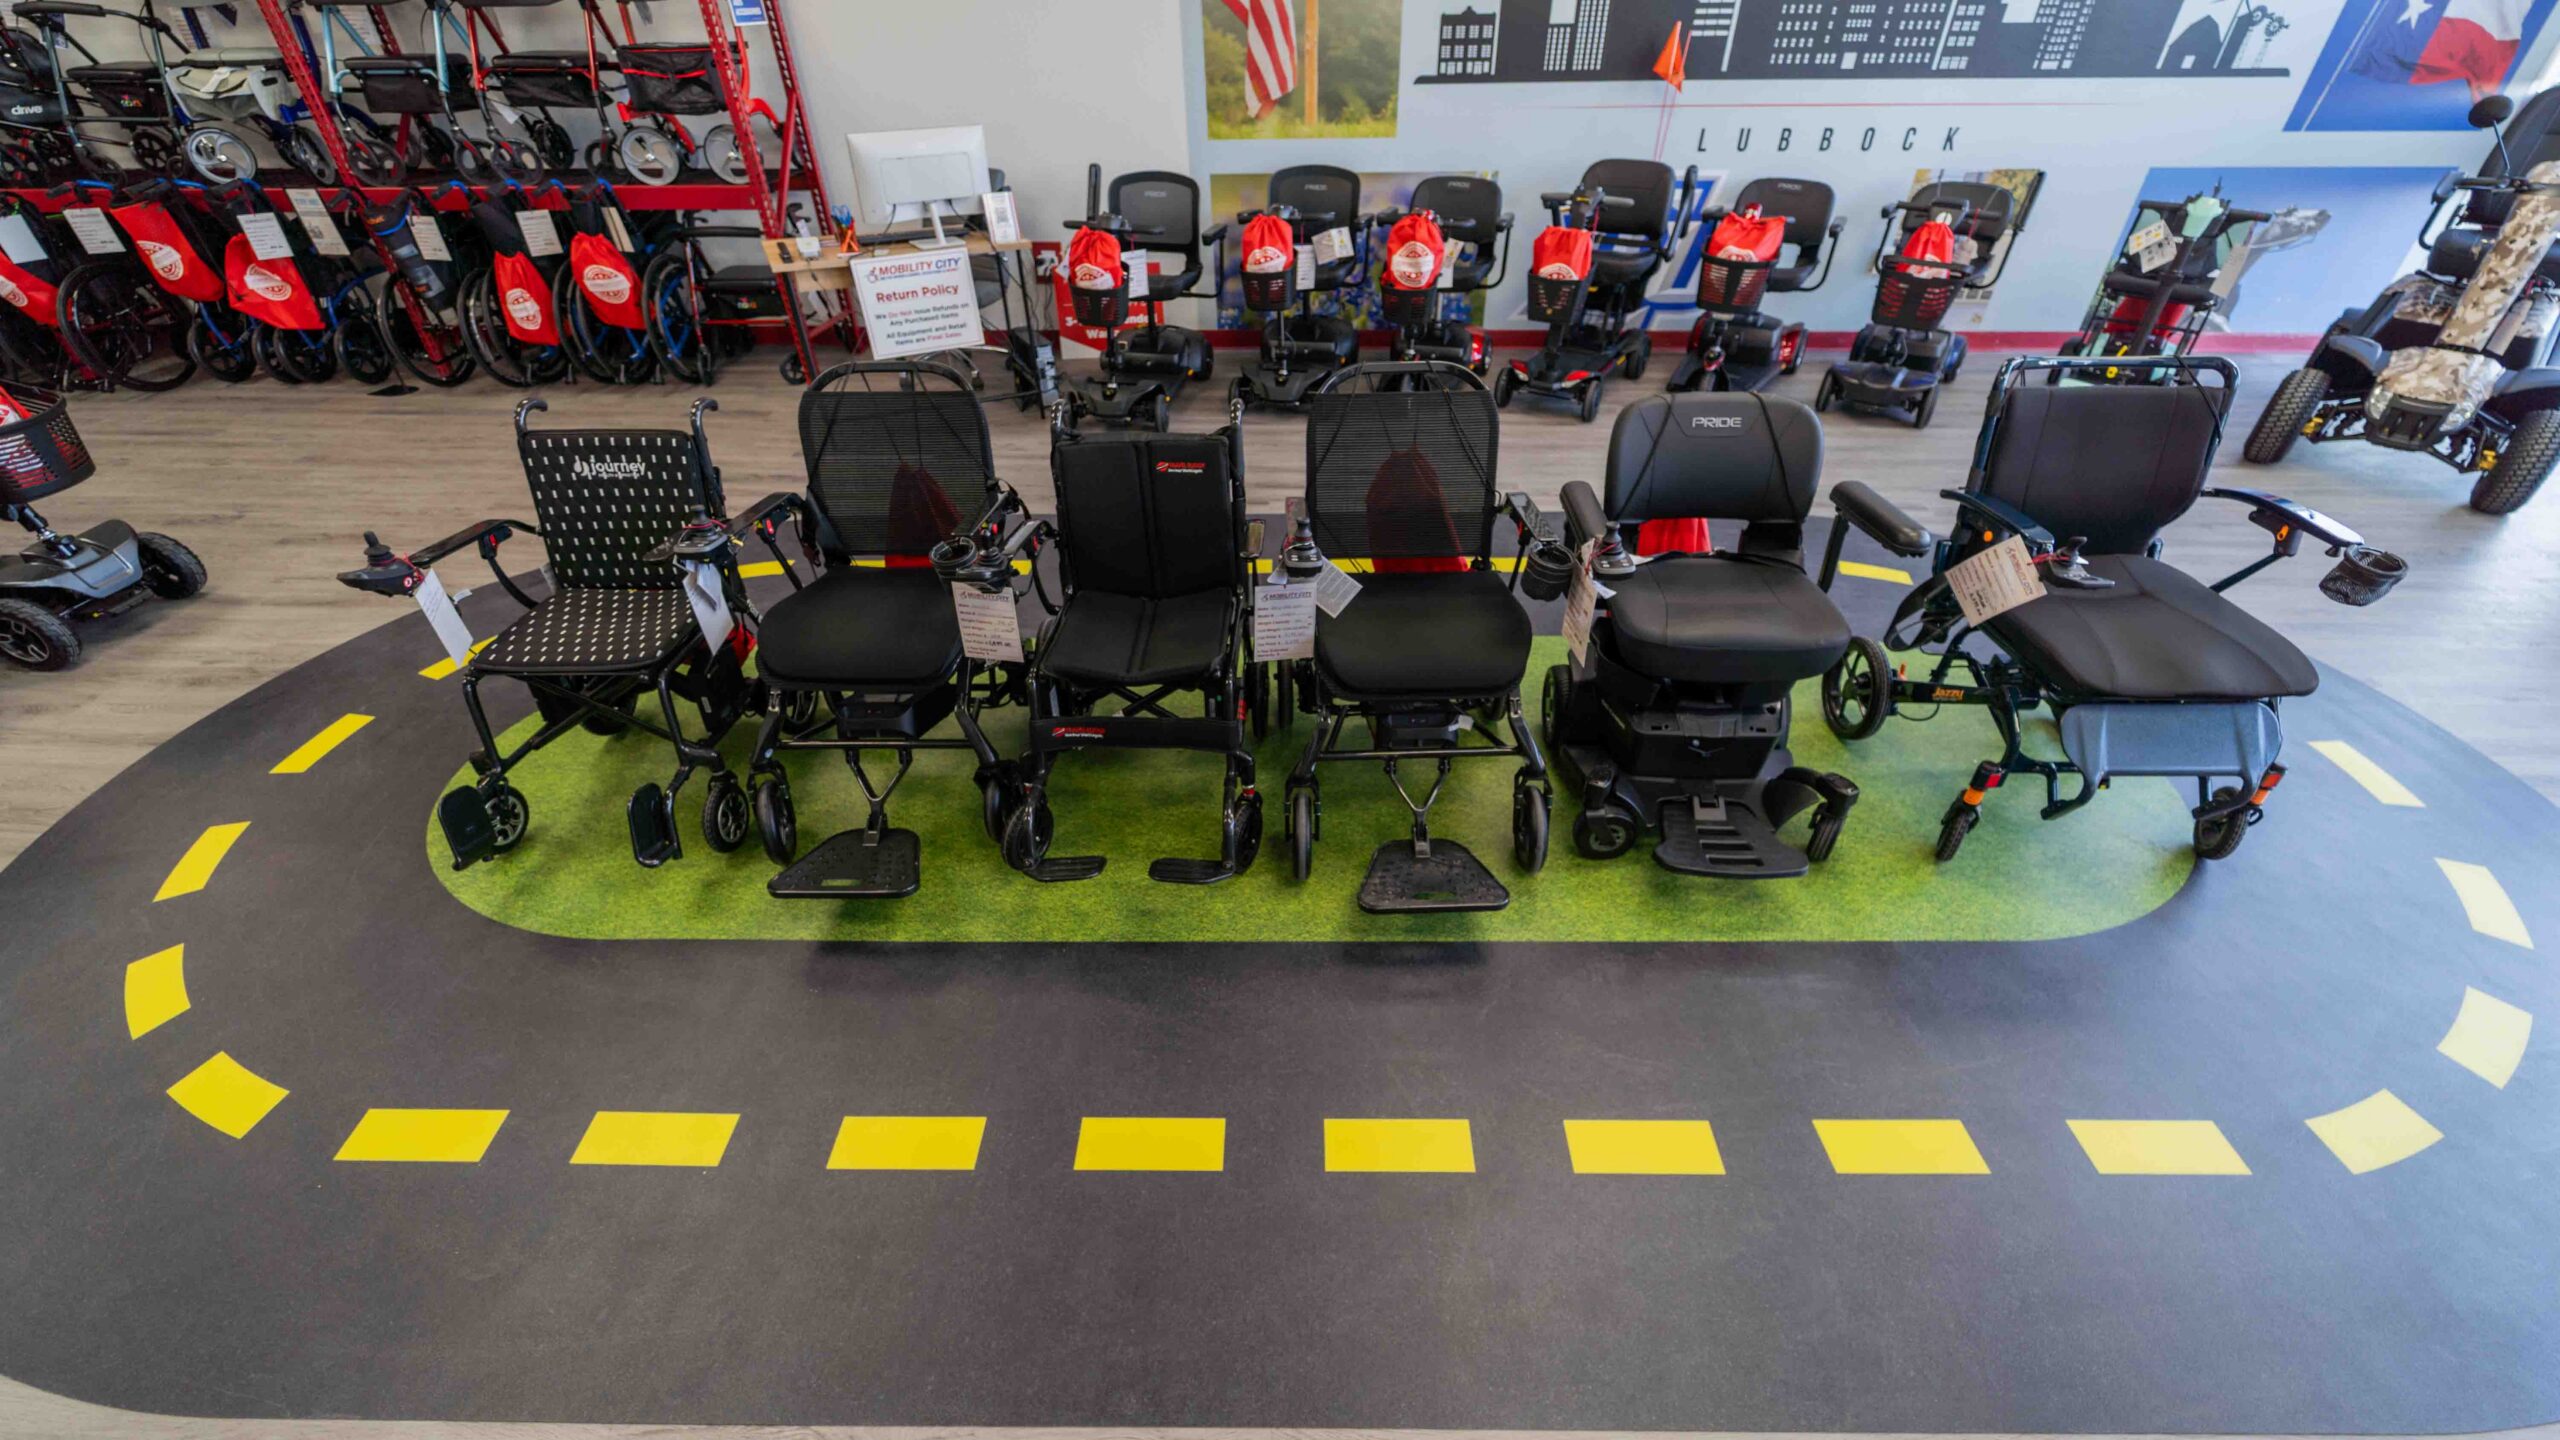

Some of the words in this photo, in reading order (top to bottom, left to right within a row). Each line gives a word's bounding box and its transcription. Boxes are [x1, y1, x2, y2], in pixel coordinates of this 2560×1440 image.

[10, 105, 43, 115] drive
[1697, 127, 1960, 151] LUBBOCK
[879, 261, 933, 276] MOBILITY
[935, 257, 961, 270] CITY
[876, 289, 918, 303] Return
[922, 284, 959, 296] Policy
[1692, 416, 1743, 428] PRIDE
[589, 460, 646, 476] journey
